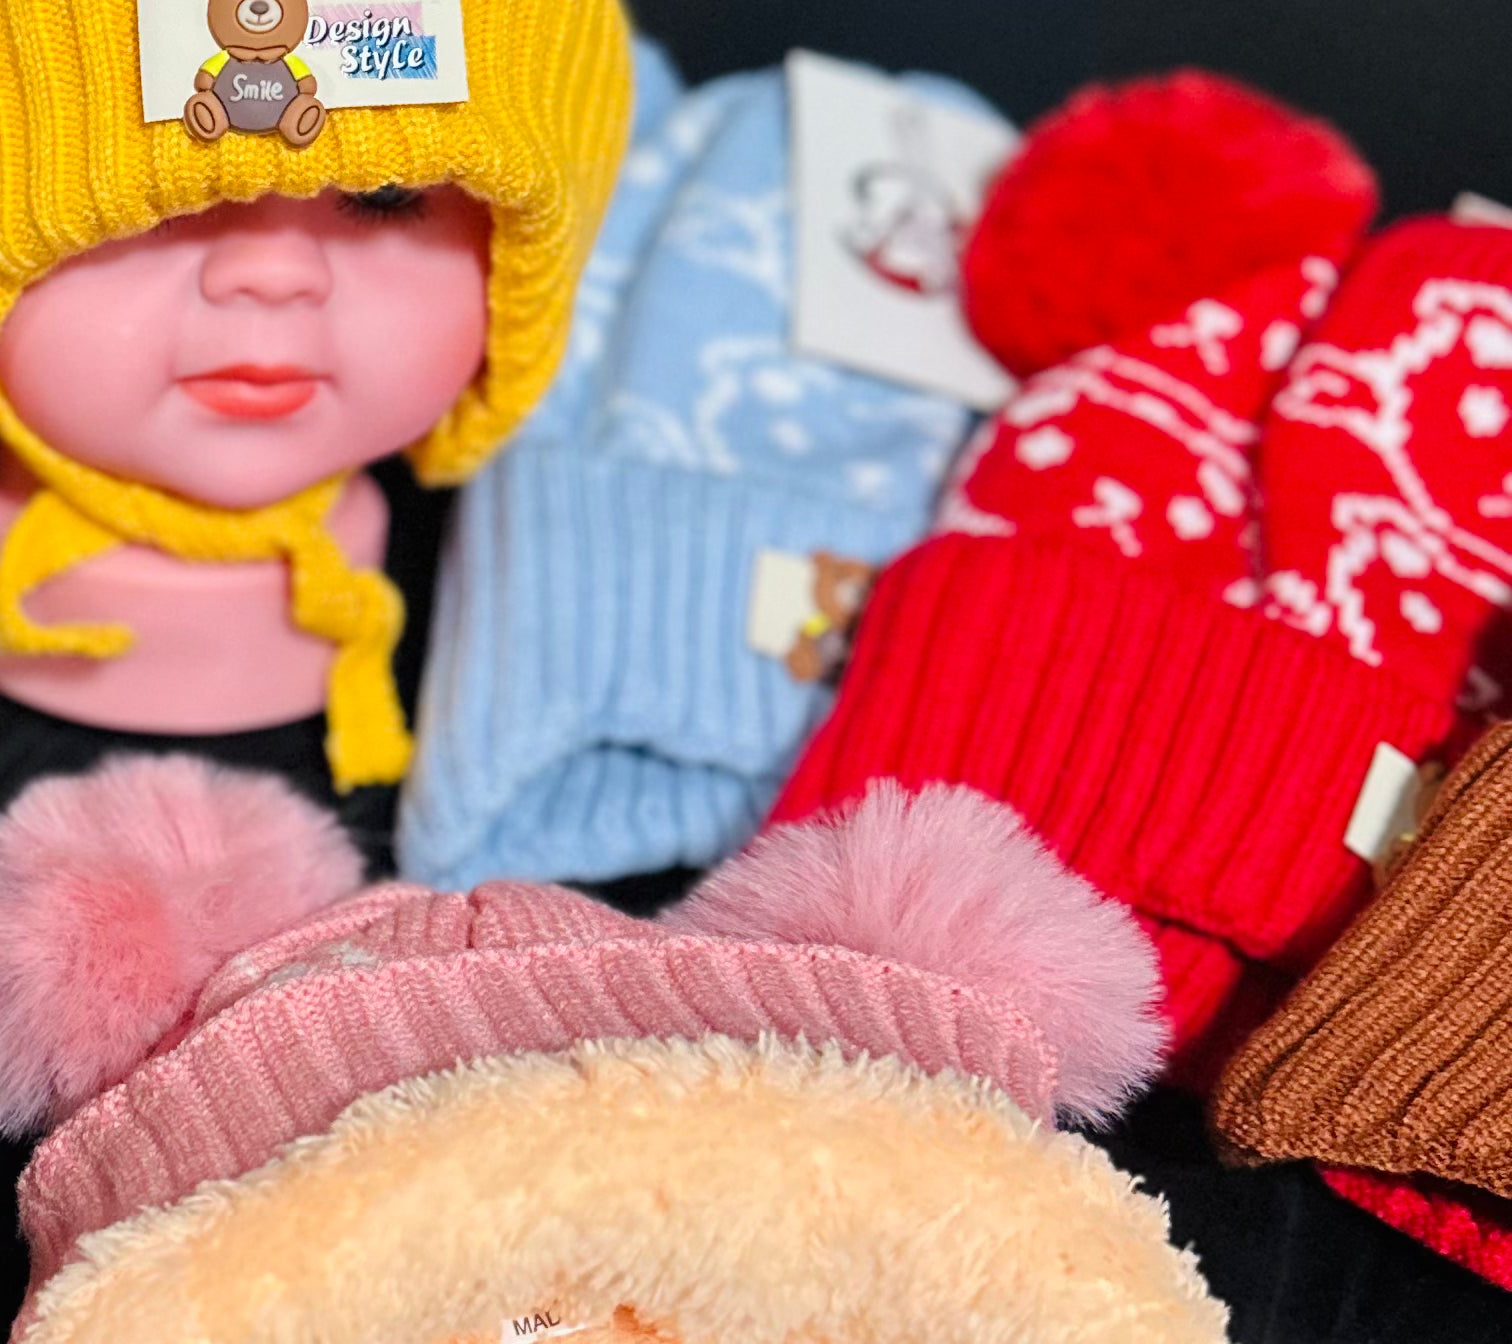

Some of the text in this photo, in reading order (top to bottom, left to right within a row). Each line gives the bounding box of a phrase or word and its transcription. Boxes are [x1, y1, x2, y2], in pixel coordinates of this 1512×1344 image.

[305, 10, 413, 47] Design
[341, 39, 426, 80] Style
[230, 74, 284, 102] Smile
